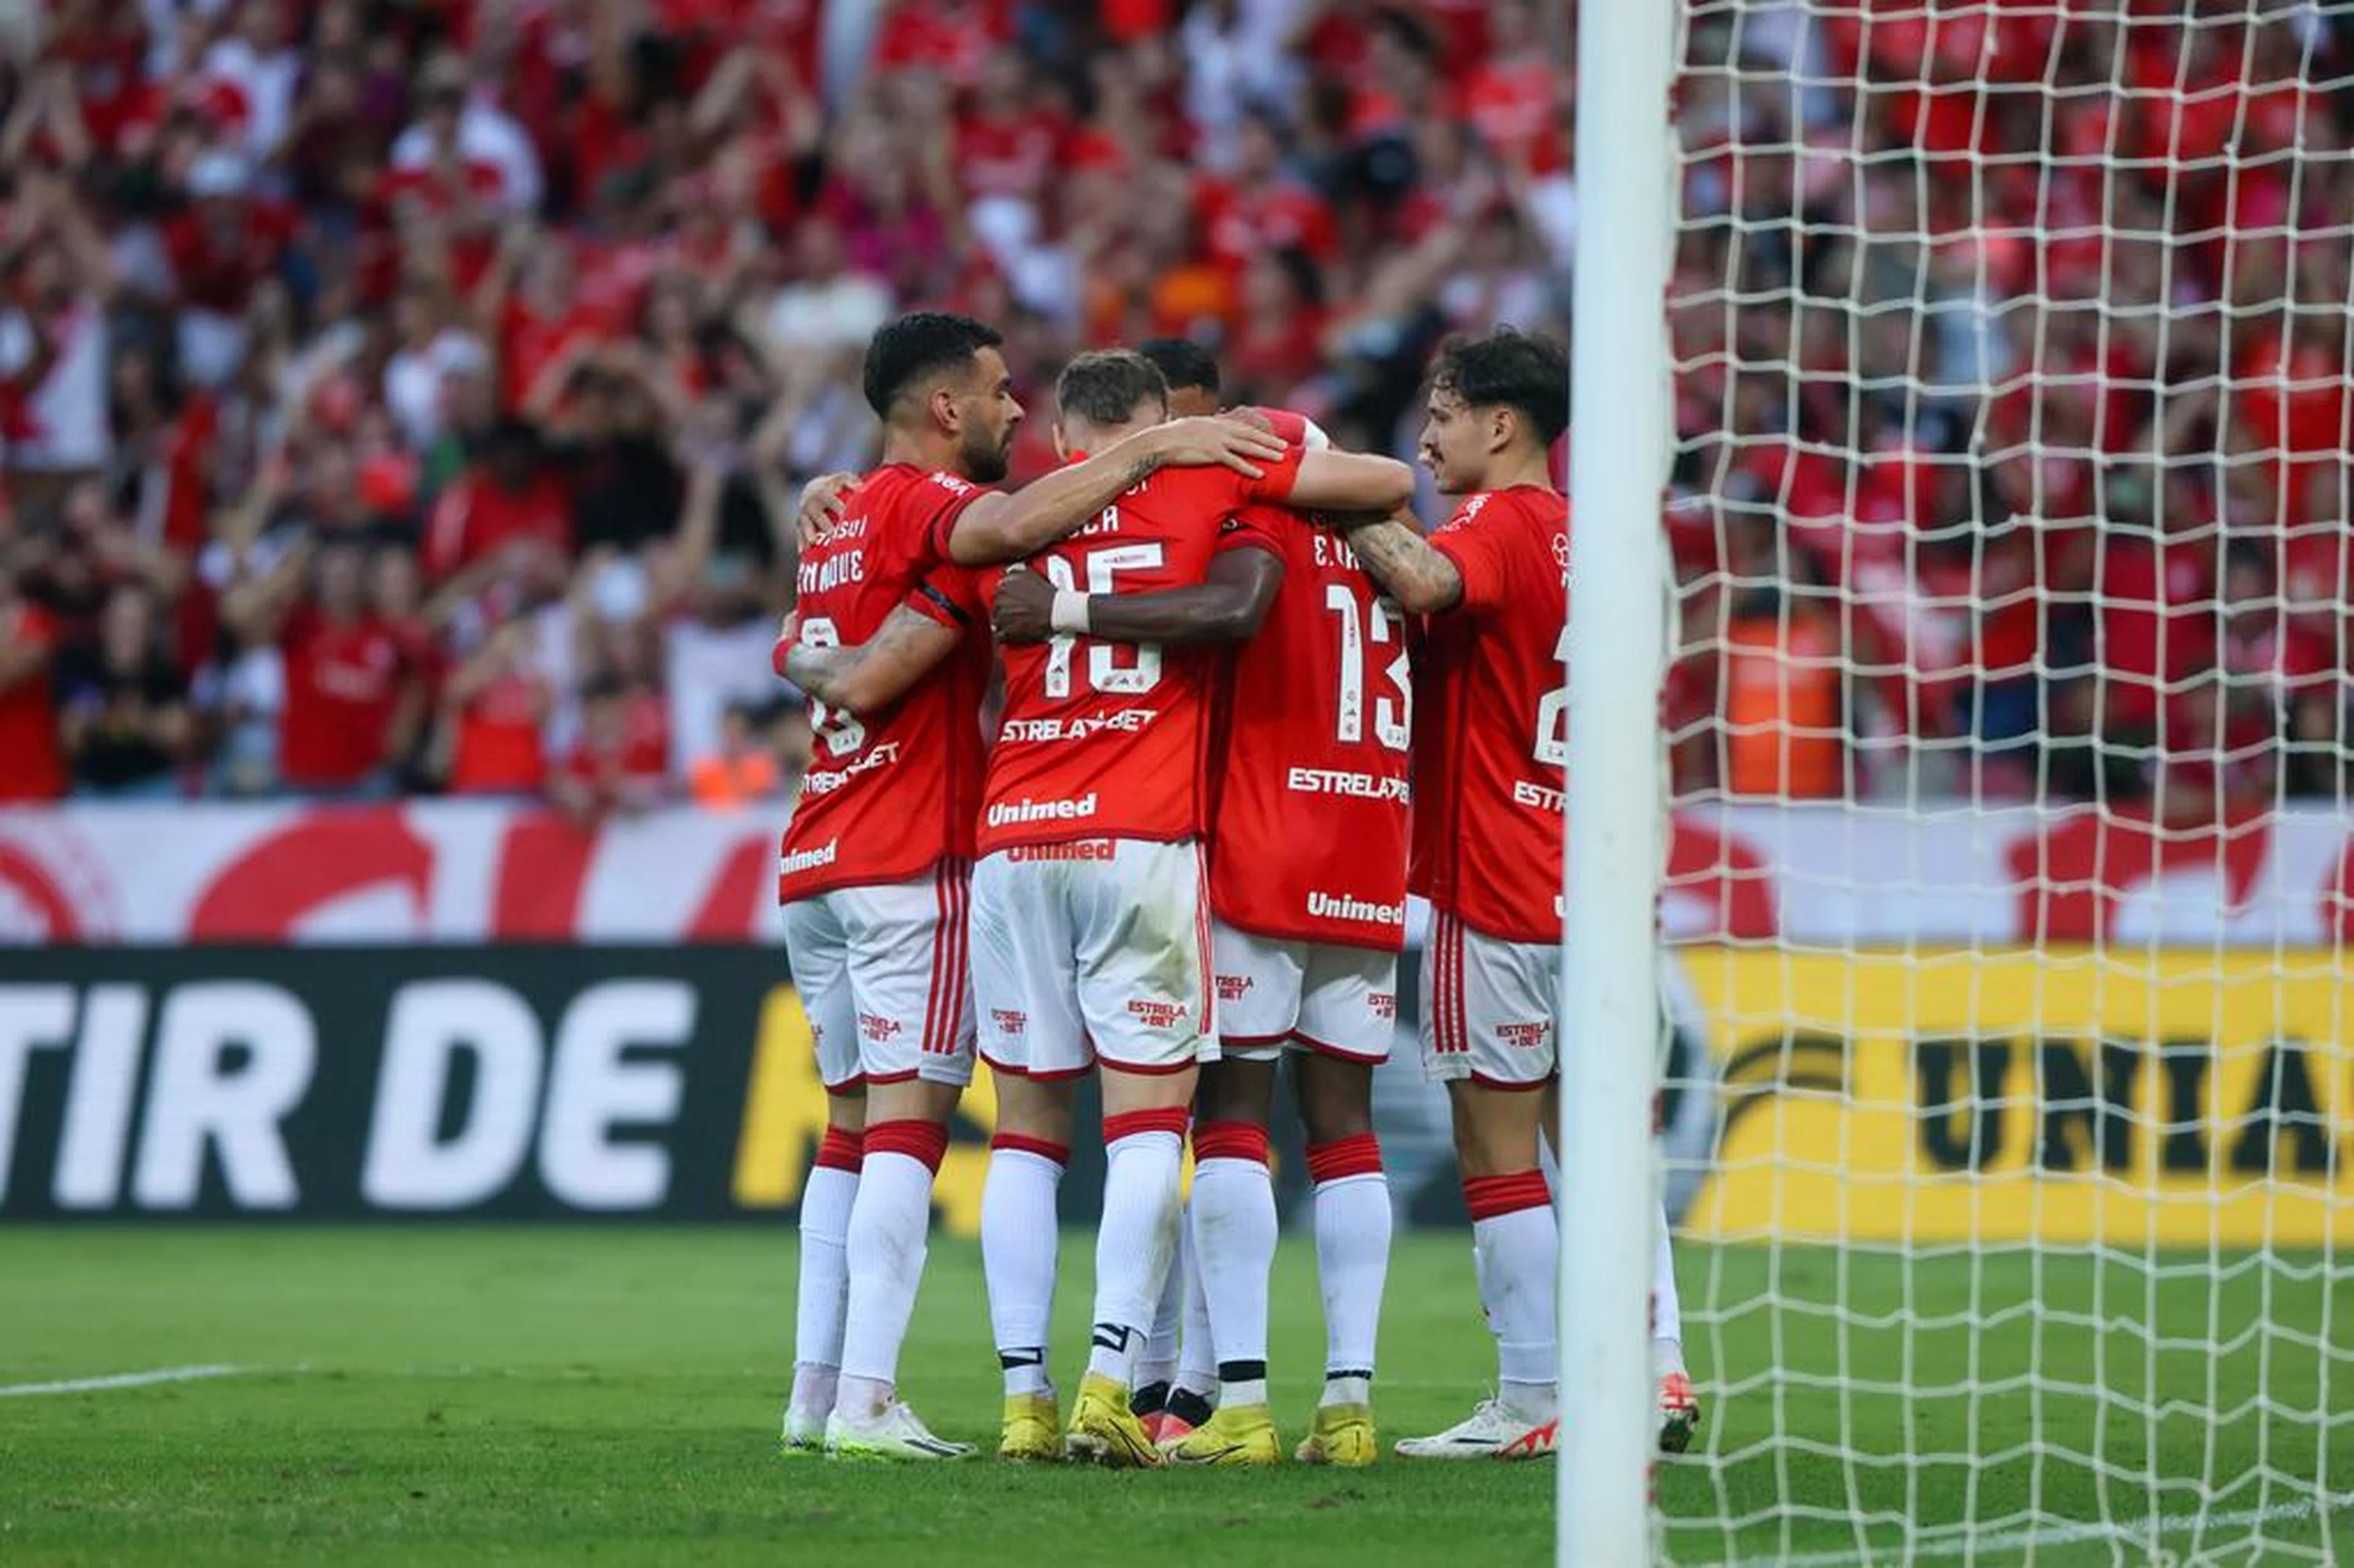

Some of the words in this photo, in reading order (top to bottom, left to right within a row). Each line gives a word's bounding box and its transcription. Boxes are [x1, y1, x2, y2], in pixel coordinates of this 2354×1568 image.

[1045, 543, 1162, 697] 15
[1327, 585, 1412, 752] 13
[988, 793, 1097, 828] Unimed
[780, 837, 837, 875] nimed
[1307, 891, 1404, 925] Unimed
[1128, 1000, 1187, 1018] ESTRELA
[360, 980, 696, 1209] DE
[1913, 1037, 2340, 1175] UNIA
